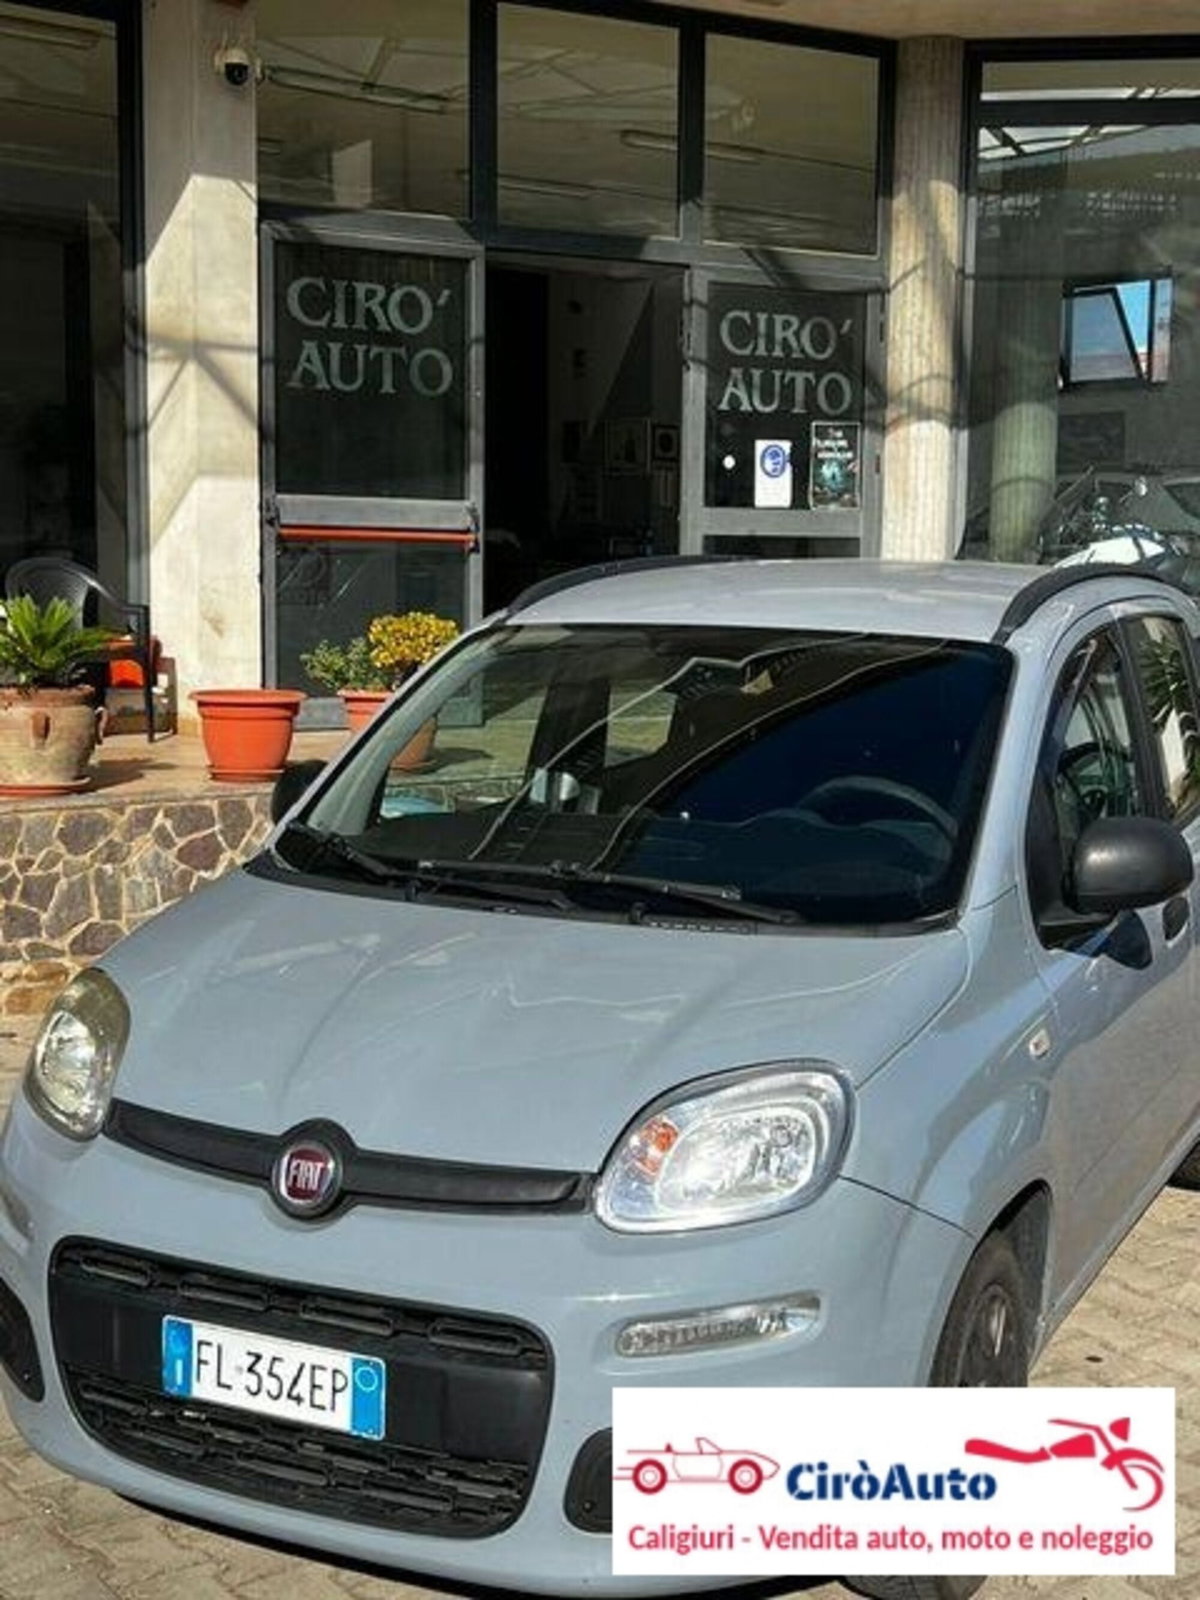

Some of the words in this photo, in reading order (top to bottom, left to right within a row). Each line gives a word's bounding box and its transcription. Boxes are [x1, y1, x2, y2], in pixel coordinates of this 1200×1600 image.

[286, 339, 453, 397] AUTO
[717, 367, 852, 415] AUTO
[288, 1159, 324, 1191] FIAT
